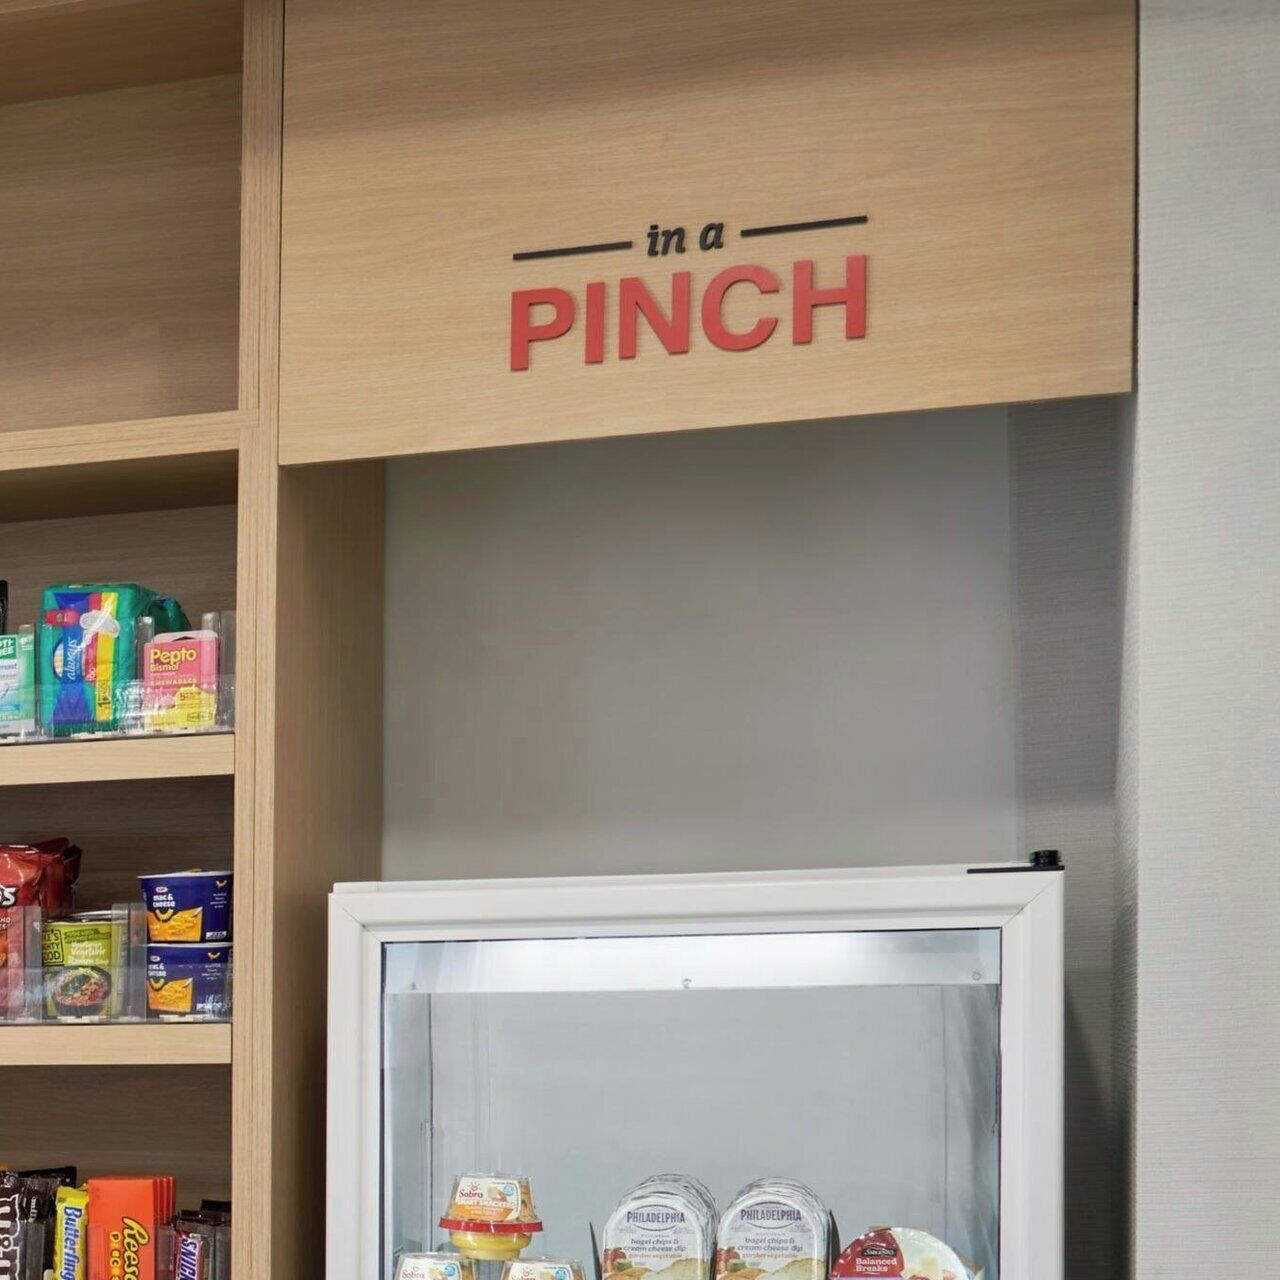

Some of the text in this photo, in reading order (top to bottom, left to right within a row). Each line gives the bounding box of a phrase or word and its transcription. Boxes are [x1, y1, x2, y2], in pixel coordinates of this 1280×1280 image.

[647, 222, 724, 257] in a
[510, 254, 868, 371] PINCH
[65, 638, 80, 680] always
[150, 648, 197, 664] Pepto
[150, 663, 180, 672] Bismol
[458, 1189, 484, 1199] Sabra
[626, 1211, 686, 1224] PHILADELPHIA
[740, 1208, 802, 1222] PHILADELPHIA
[630, 1238, 650, 1246] bagel
[652, 1238, 672, 1246] chips
[855, 1258, 898, 1266] Balanced
[402, 1270, 425, 1280] Sabra
